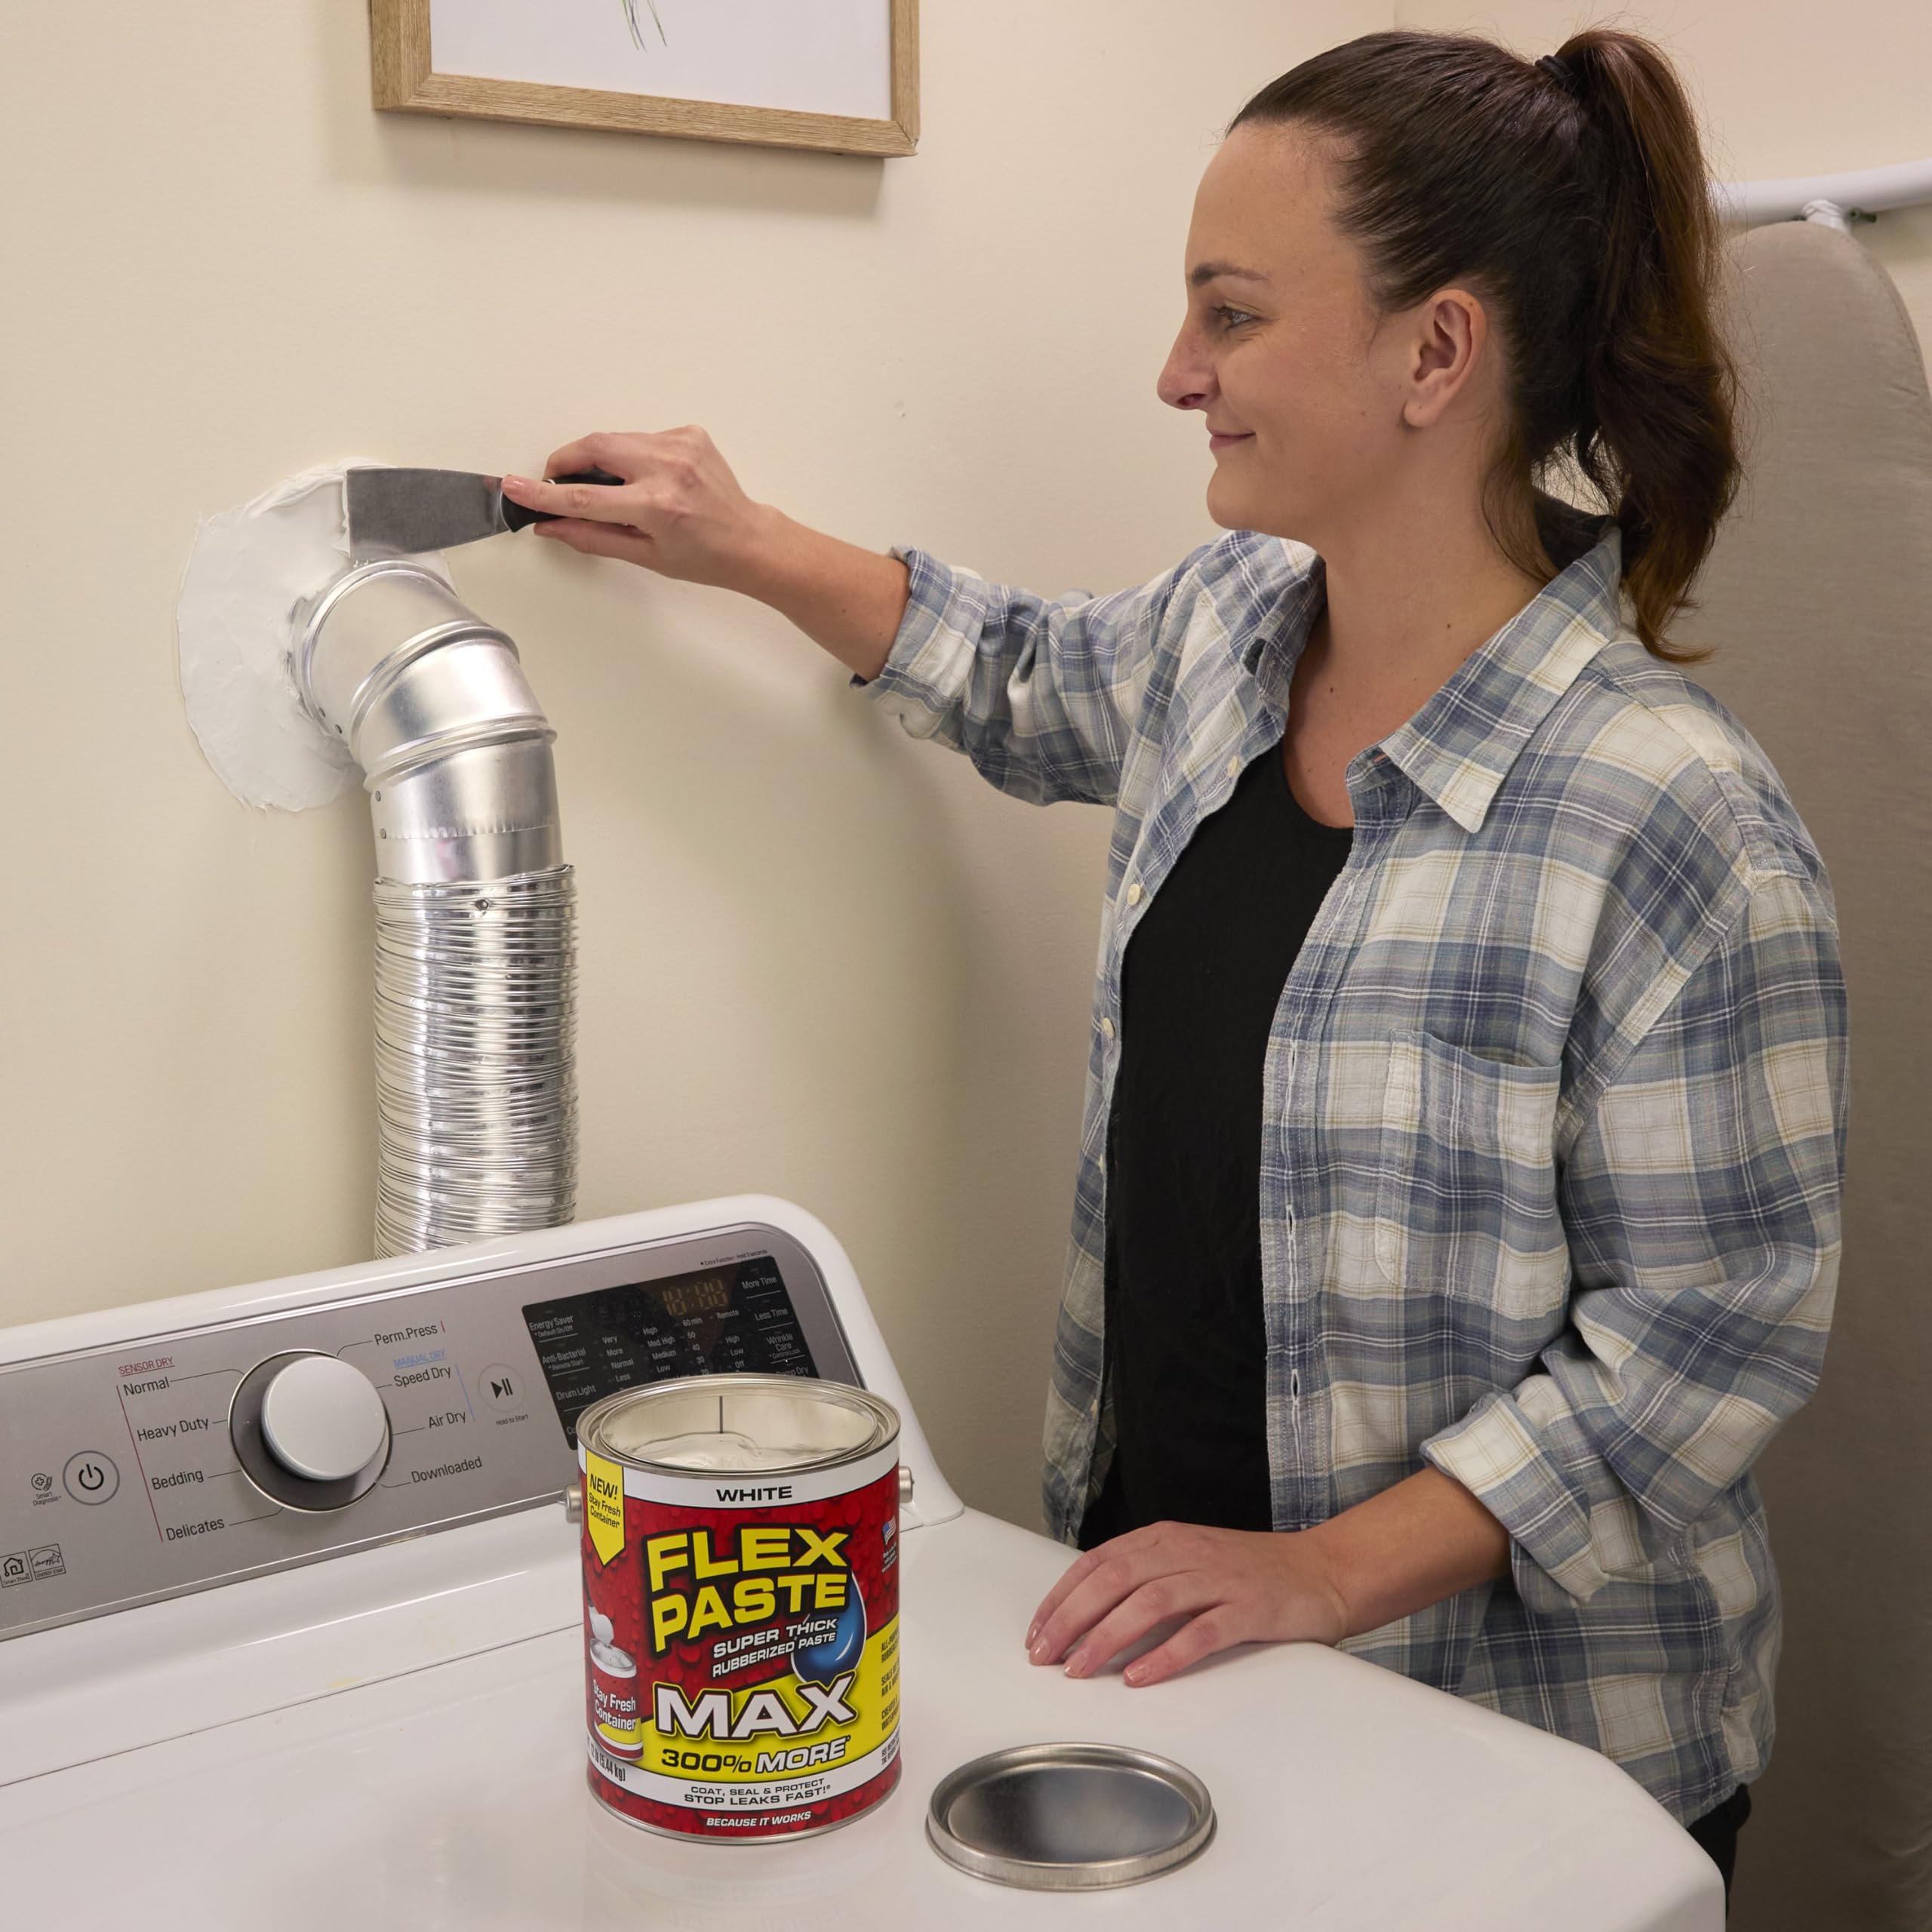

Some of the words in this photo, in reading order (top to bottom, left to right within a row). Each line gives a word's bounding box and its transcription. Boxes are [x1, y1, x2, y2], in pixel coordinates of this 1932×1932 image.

[742, 1278, 760, 1289] More
[761, 1275, 777, 1284] Time
[529, 1319, 554, 1331] Energy
[553, 1315, 574, 1326] Saver
[755, 1312, 771, 1321] Less
[771, 1308, 789, 1317] Time
[374, 1324, 438, 1345] Perm.Press
[602, 1335, 617, 1345] Very
[767, 1333, 793, 1345] Wrinkle
[429, 1349, 446, 1360] DRY
[542, 1347, 586, 1364] Anti-Bacterial
[652, 1349, 677, 1360] Medium
[731, 1348, 744, 1356] Low
[775, 1343, 792, 1352] Care
[118, 1361, 155, 1375] SENSOR
[155, 1356, 174, 1367] DRY
[611, 1358, 635, 1370] Normal
[657, 1364, 671, 1373] Low
[735, 1360, 745, 1369] Off
[123, 1376, 170, 1396] Normal
[393, 1369, 430, 1388] Speed
[431, 1367, 452, 1379] Dry
[556, 1390, 577, 1401] Drum
[577, 1384, 596, 1396] Light
[428, 1415, 444, 1429] Air
[446, 1411, 466, 1424] Dry
[515, 1414, 528, 1422] Start
[137, 1424, 177, 1442] Heavy
[180, 1418, 209, 1432] Duty
[411, 1456, 483, 1484] Downloaded
[151, 1470, 205, 1491] Bedding
[590, 1473, 618, 1500] NEW!
[716, 1485, 792, 1502] WHITE
[589, 1492, 601, 1510] Stay
[601, 1500, 621, 1517] Fresh
[590, 1506, 620, 1528] Container
[166, 1518, 225, 1541] Delicates
[647, 1528, 849, 1592] FLEX
[651, 1574, 848, 1653] PASTE
[713, 1628, 780, 1659] SUPER
[786, 1617, 838, 1638] THICK
[712, 1641, 795, 1678] RUBBERIZED
[798, 1632, 836, 1650] PASTE
[593, 1679, 608, 1708] Stay
[610, 1693, 636, 1711] Fresh
[595, 1700, 636, 1730] Container
[655, 1673, 857, 1739] MAX
[661, 1749, 752, 1773] 300%
[614, 1762, 626, 1782] kg)
[691, 1786, 726, 1796] COAT,
[730, 1788, 757, 1796] SEAL
[775, 1778, 825, 1792] PROTECT
[685, 1794, 724, 1805] STOP
[730, 1795, 780, 1805] LEAKS
[706, 1817, 757, 1826] BECAUSE
[759, 1817, 769, 1826] IT
[771, 1811, 811, 1825] WORKS
